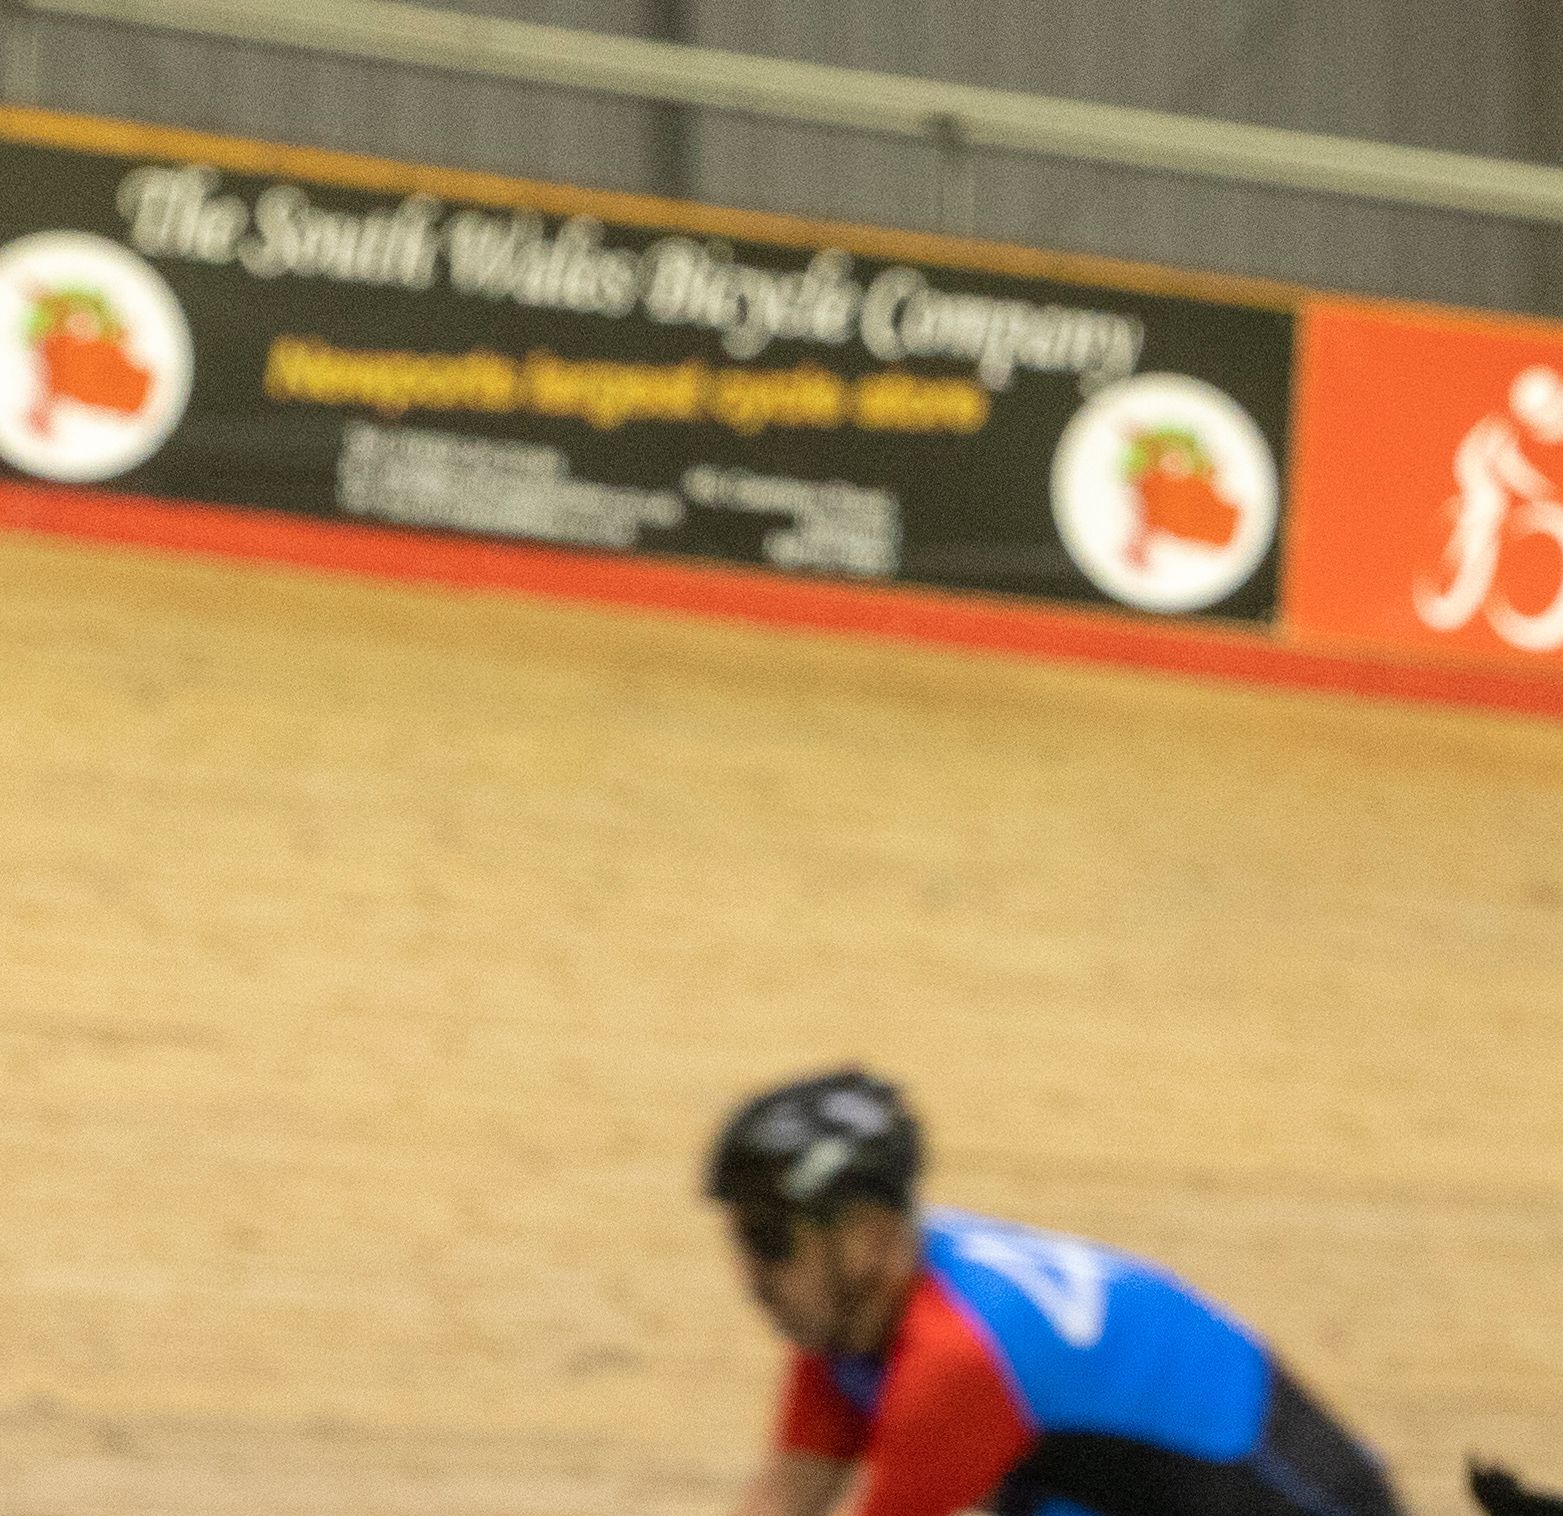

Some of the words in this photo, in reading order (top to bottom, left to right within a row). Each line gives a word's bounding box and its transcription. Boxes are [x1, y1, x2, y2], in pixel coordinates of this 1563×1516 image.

[239, 185, 442, 290] South
[446, 208, 640, 318] Wales
[642, 236, 861, 359] Bicycle
[861, 266, 1144, 400] Company
